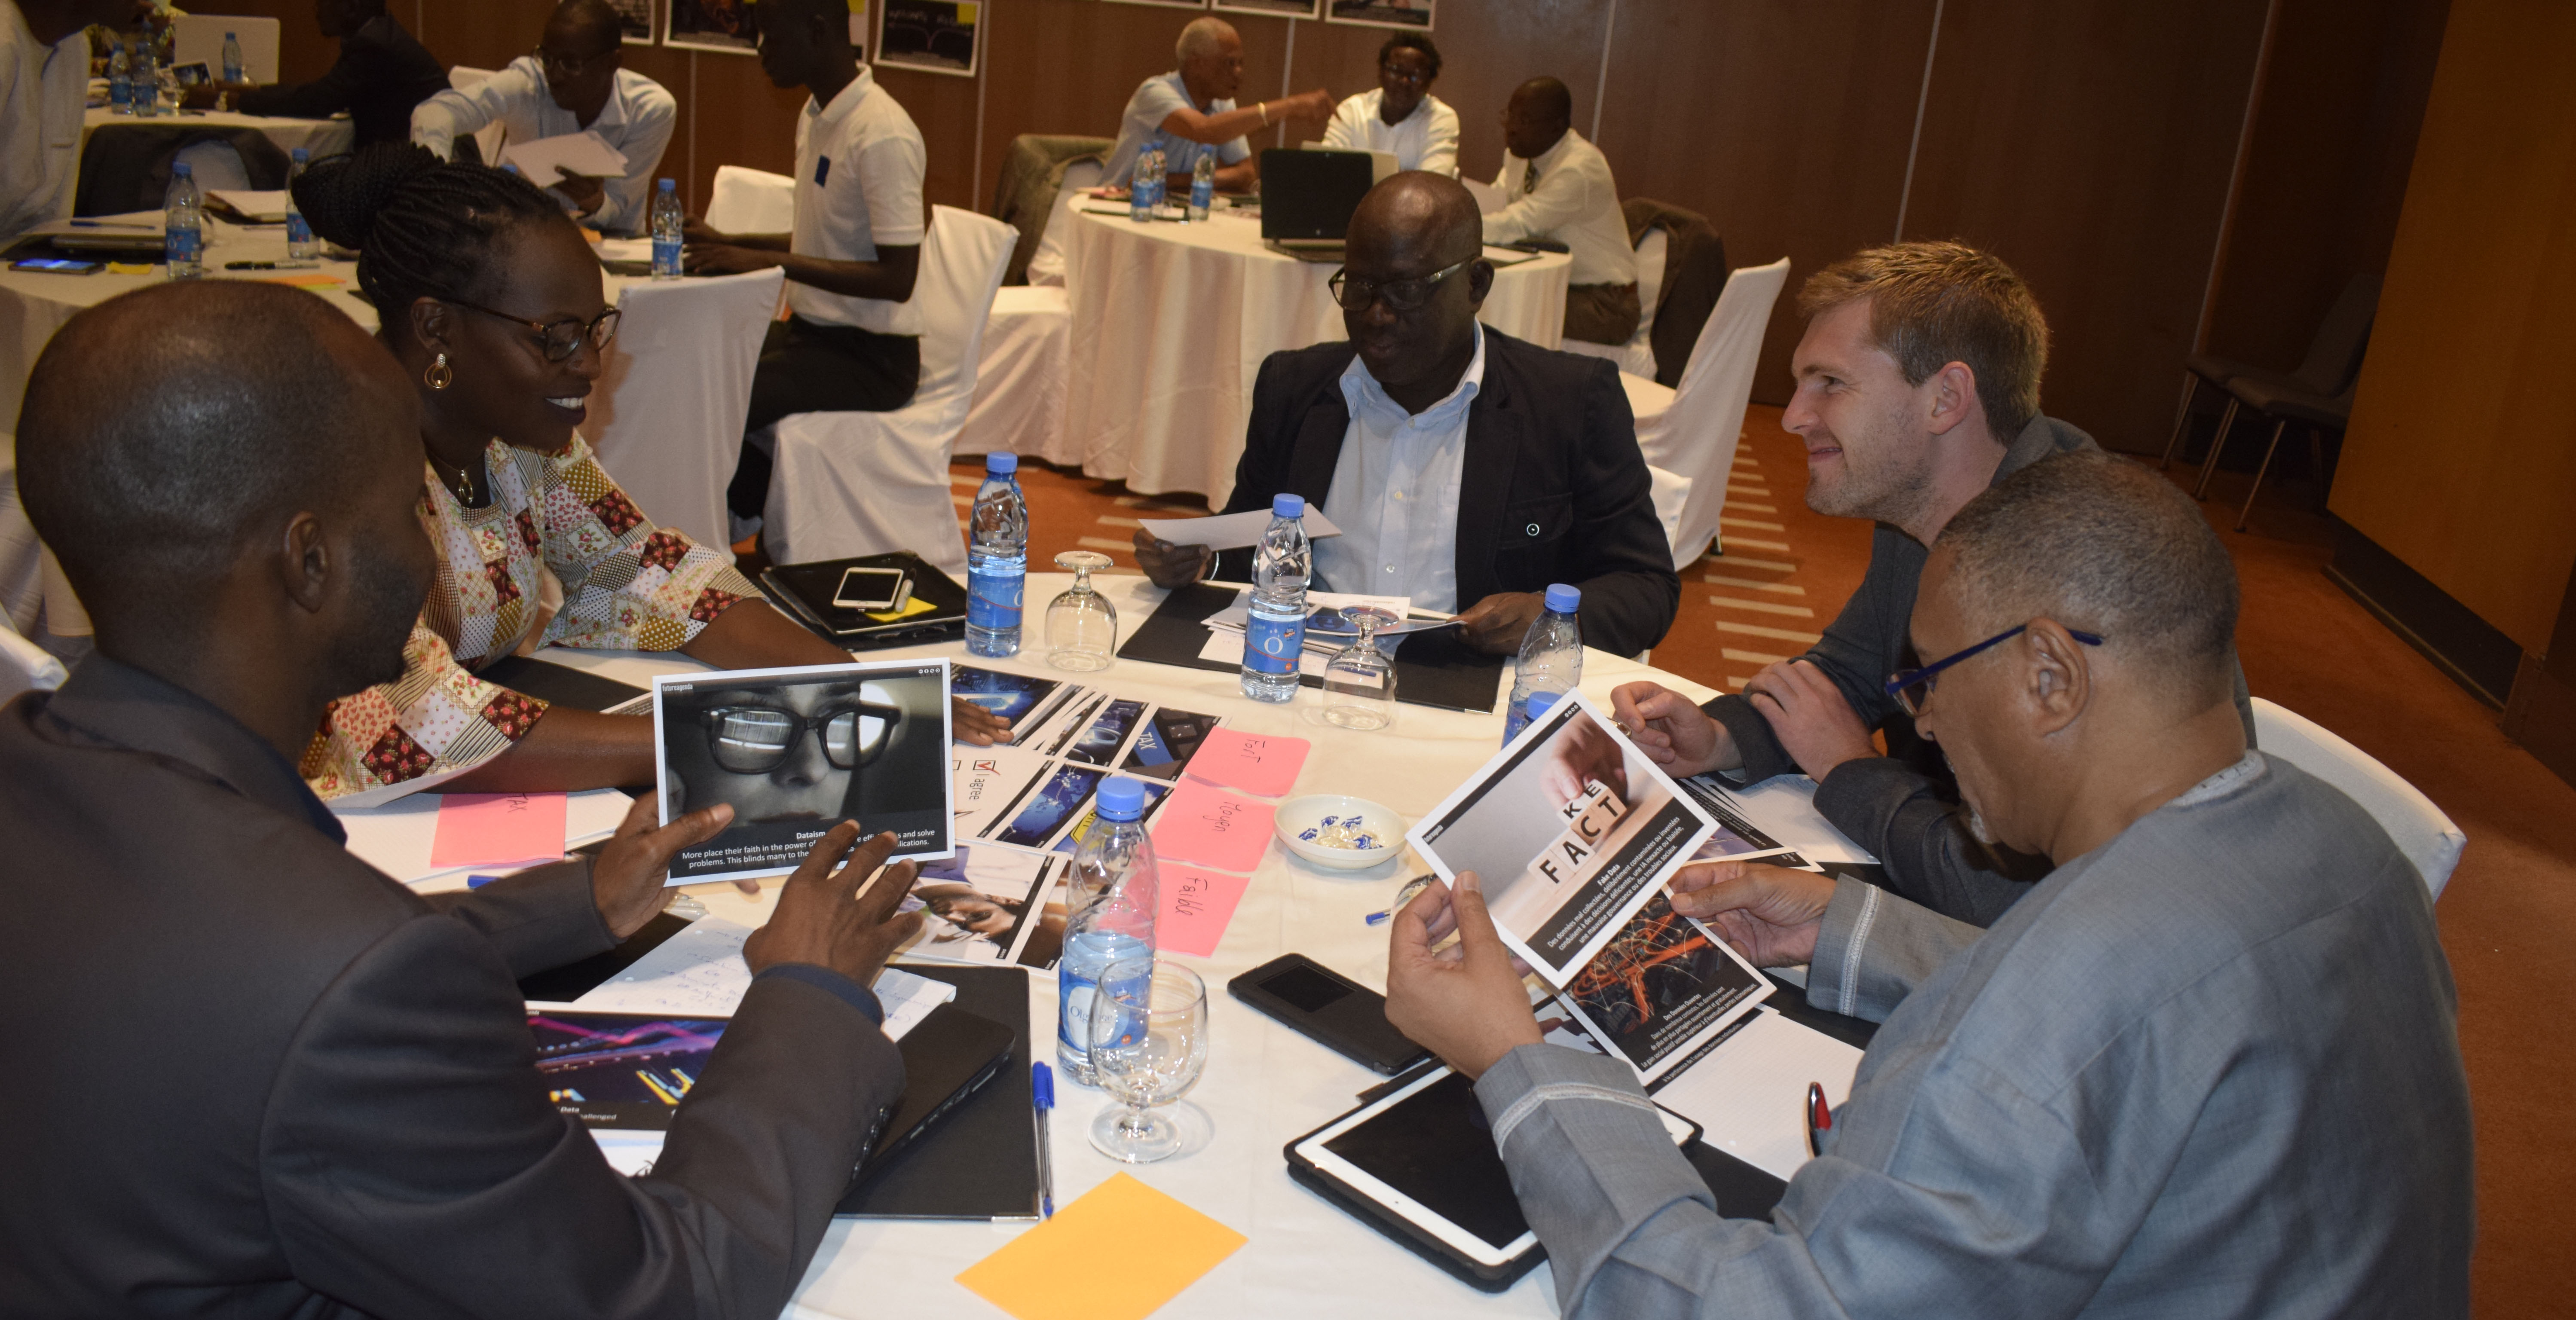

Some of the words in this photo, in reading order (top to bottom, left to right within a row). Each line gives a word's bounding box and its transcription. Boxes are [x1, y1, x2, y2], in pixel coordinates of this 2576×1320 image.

[662, 683, 693, 691] futureagenda
[1138, 732, 1157, 750] TAX
[969, 778, 985, 800] agree
[796, 831, 826, 839] Dataism
[682, 851, 702, 859] More
[704, 849, 723, 859] place
[725, 846, 742, 855] their
[744, 845, 760, 853] faith
[785, 841, 807, 850] power
[689, 859, 726, 869] problems.
[727, 856, 742, 864] This
[743, 854, 765, 863] blinds
[1547, 936, 1559, 947] Des
[1554, 919, 1576, 940] données
[1572, 910, 1585, 922] mal
[1580, 889, 1606, 915] collectées,
[1601, 863, 1632, 893] délibérément
[1628, 839, 1657, 867] contaminées
[1658, 815, 1680, 837] inventées
[1597, 873, 1610, 886] Fake
[1606, 862, 1621, 876] Data
[1557, 925, 1583, 951] conduisent
[1582, 914, 1594, 926] des
[1590, 896, 1612, 918] décisions
[1608, 873, 1635, 900] déficientes,
[1632, 865, 1643, 877] une
[1639, 860, 1648, 868] IA
[1644, 844, 1664, 864] inexacte
[1665, 824, 1685, 843] biaisée,
[1578, 933, 1589, 944] une
[1586, 913, 1609, 935] mauvaise
[1605, 888, 1635, 917] gouvernance
[1635, 874, 1646, 885] des
[1643, 858, 1663, 878] troubles
[1659, 843, 1678, 862] sociaux.
[1662, 1012, 1673, 1021] Des
